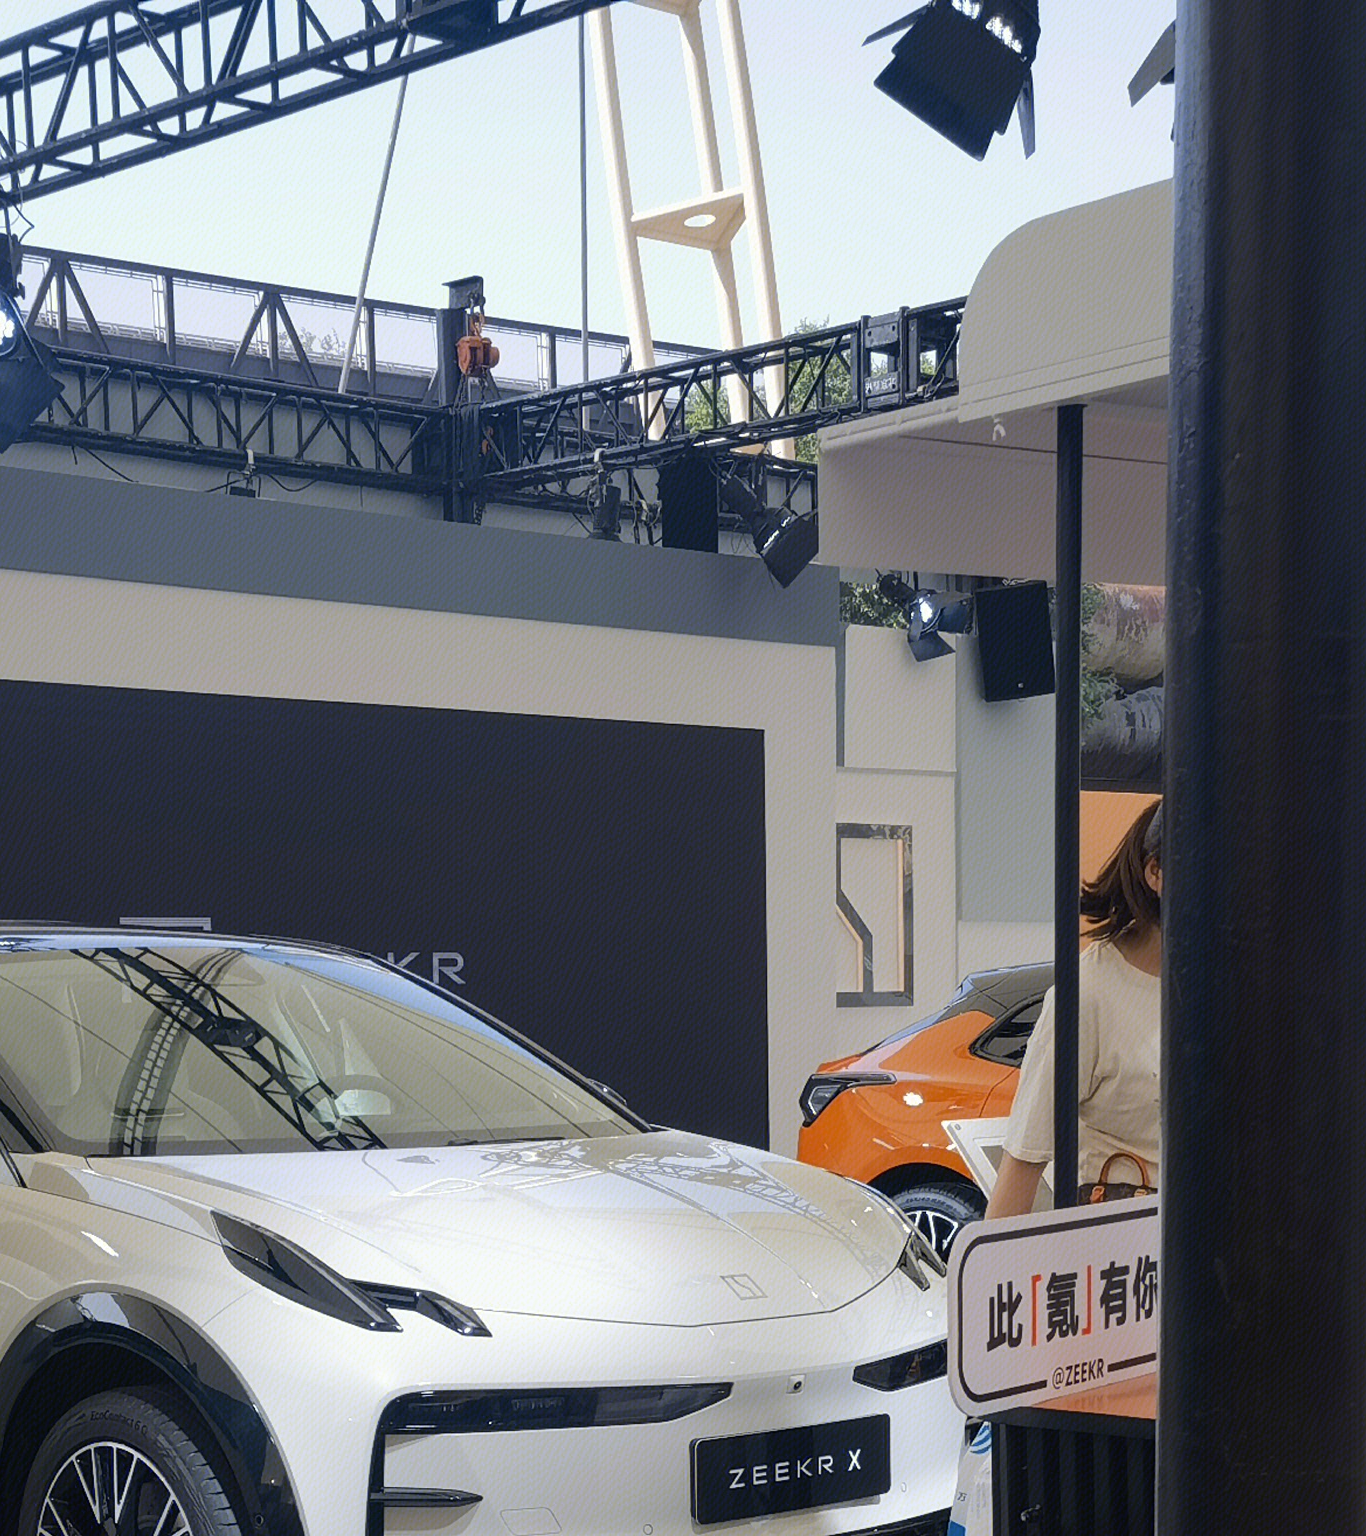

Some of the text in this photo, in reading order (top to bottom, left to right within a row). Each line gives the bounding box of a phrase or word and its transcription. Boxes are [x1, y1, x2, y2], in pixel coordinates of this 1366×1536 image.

[1052, 1358, 1105, 1390] @ZEEKR
[728, 1448, 862, 1490] ZEEKR X
